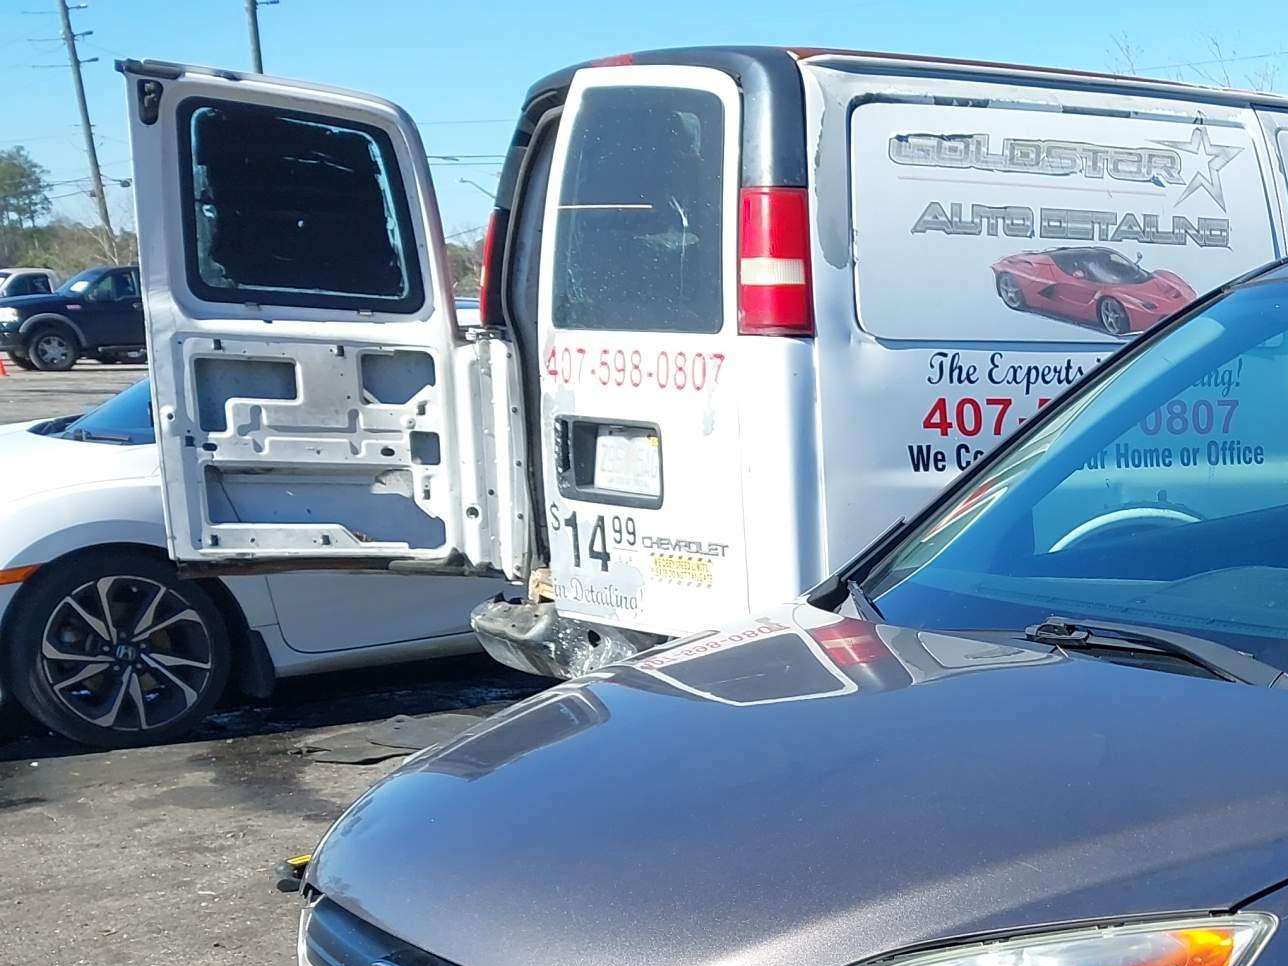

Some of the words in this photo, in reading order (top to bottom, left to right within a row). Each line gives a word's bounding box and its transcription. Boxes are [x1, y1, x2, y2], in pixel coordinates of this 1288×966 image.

[911, 201, 1036, 239] AUTO
[927, 351, 979, 385] The
[908, 444, 946, 473] We
[1115, 443, 1173, 470] Home
[1180, 447, 1200, 467] or
[1207, 440, 1265, 466] Office
[641, 536, 730, 558] CHEVROLET
